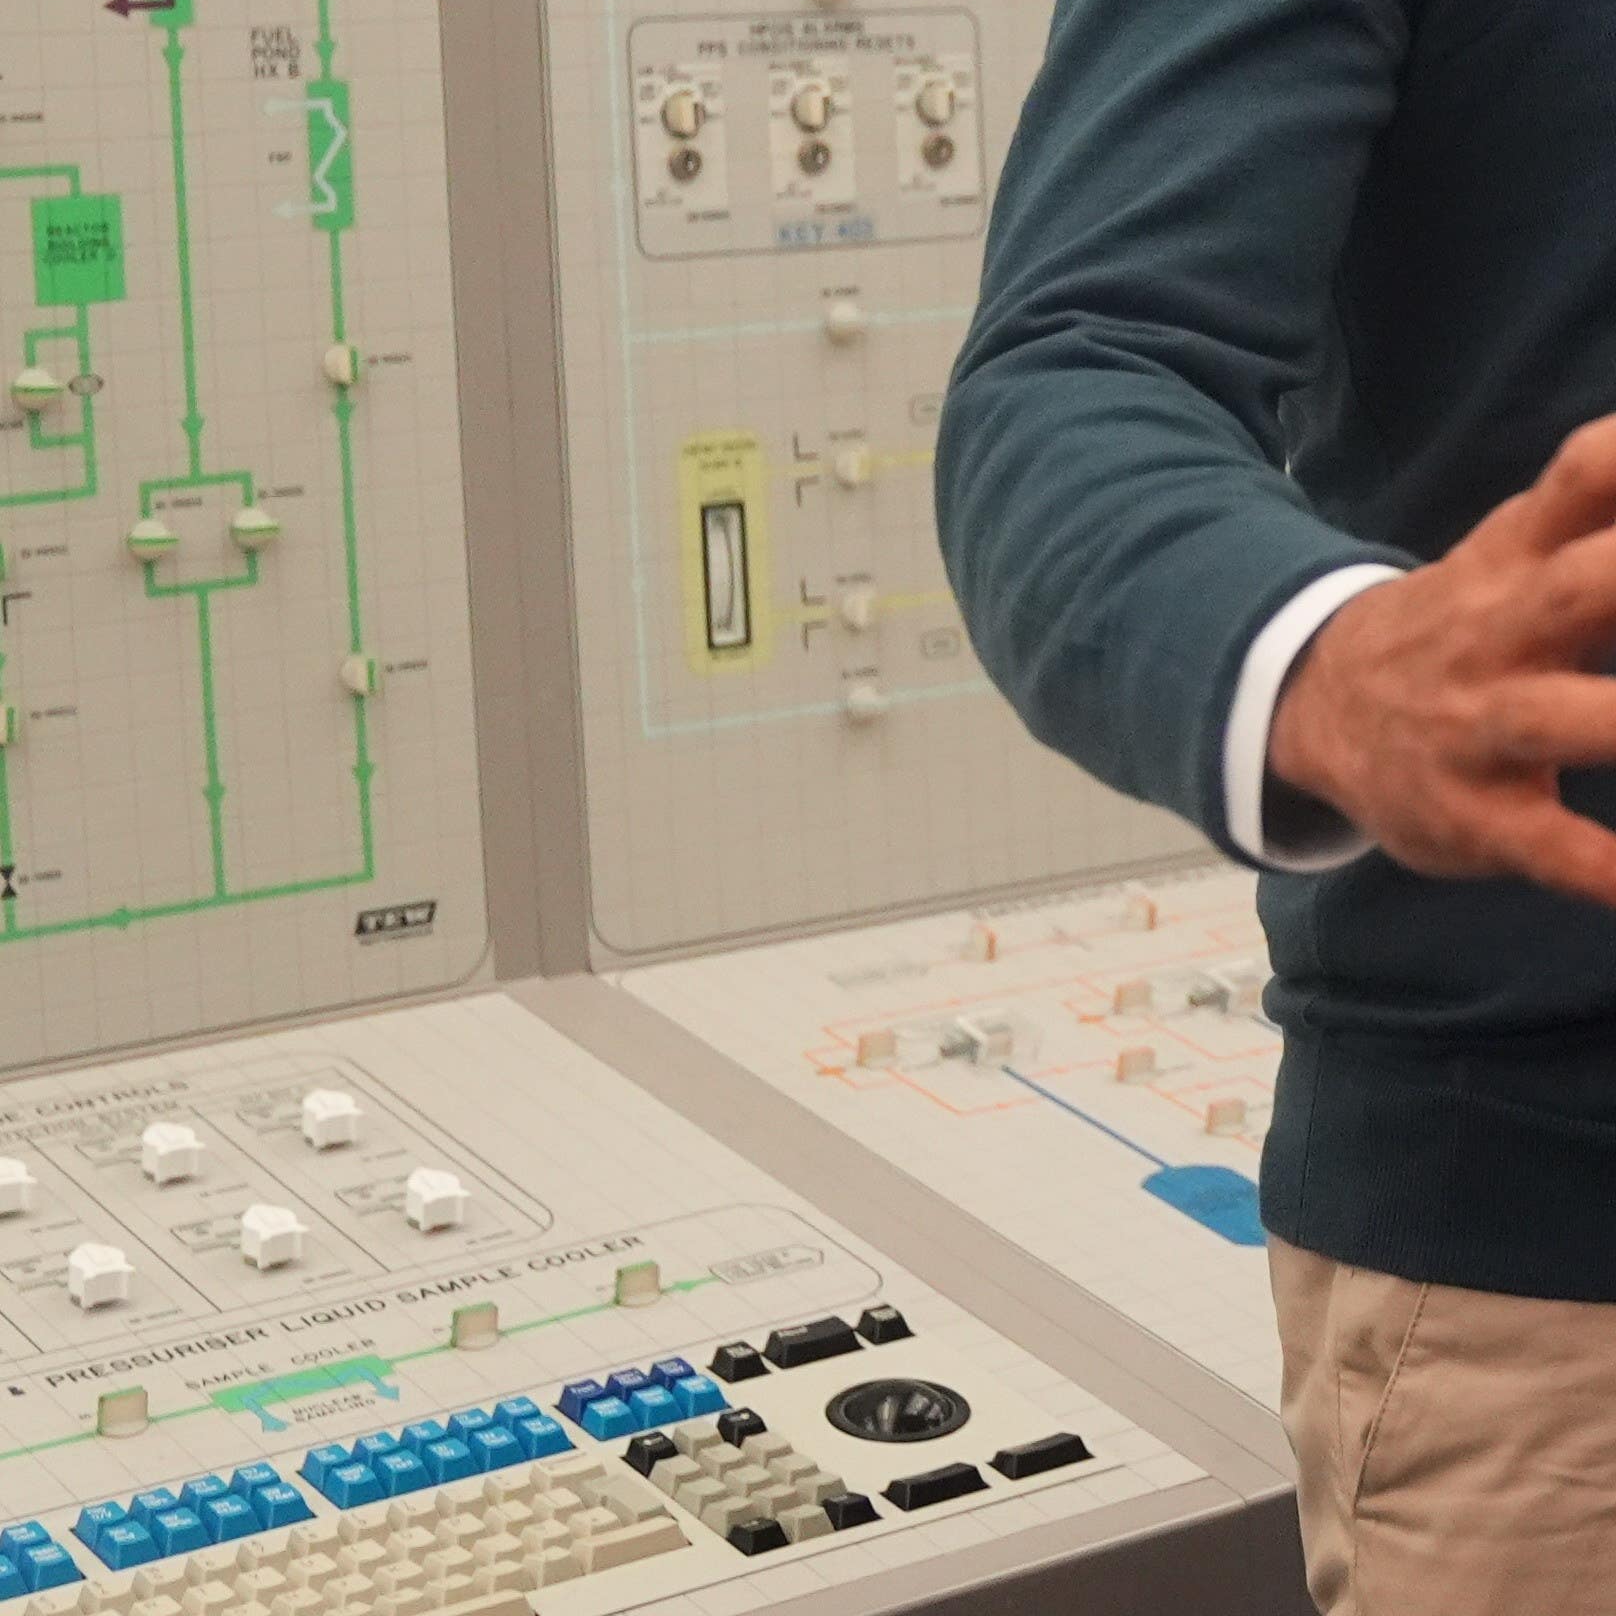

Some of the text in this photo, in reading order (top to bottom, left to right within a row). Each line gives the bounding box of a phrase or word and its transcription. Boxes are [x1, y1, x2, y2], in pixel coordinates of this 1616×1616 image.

[250, 26, 292, 41] FUEL
[251, 42, 300, 60] POND
[255, 61, 278, 78] HX
[34, 1082, 190, 1117] CONTROLS
[45, 1323, 269, 1388] PRESSURISER
[277, 1296, 386, 1334] LIQUID
[395, 1264, 516, 1305] SAMPLE
[527, 1234, 645, 1273] COOLER
[185, 1337, 377, 1390] SAMPLE COOLER
[292, 1393, 362, 1415] NUCLEAR
[295, 1399, 375, 1422] SAMPLING
